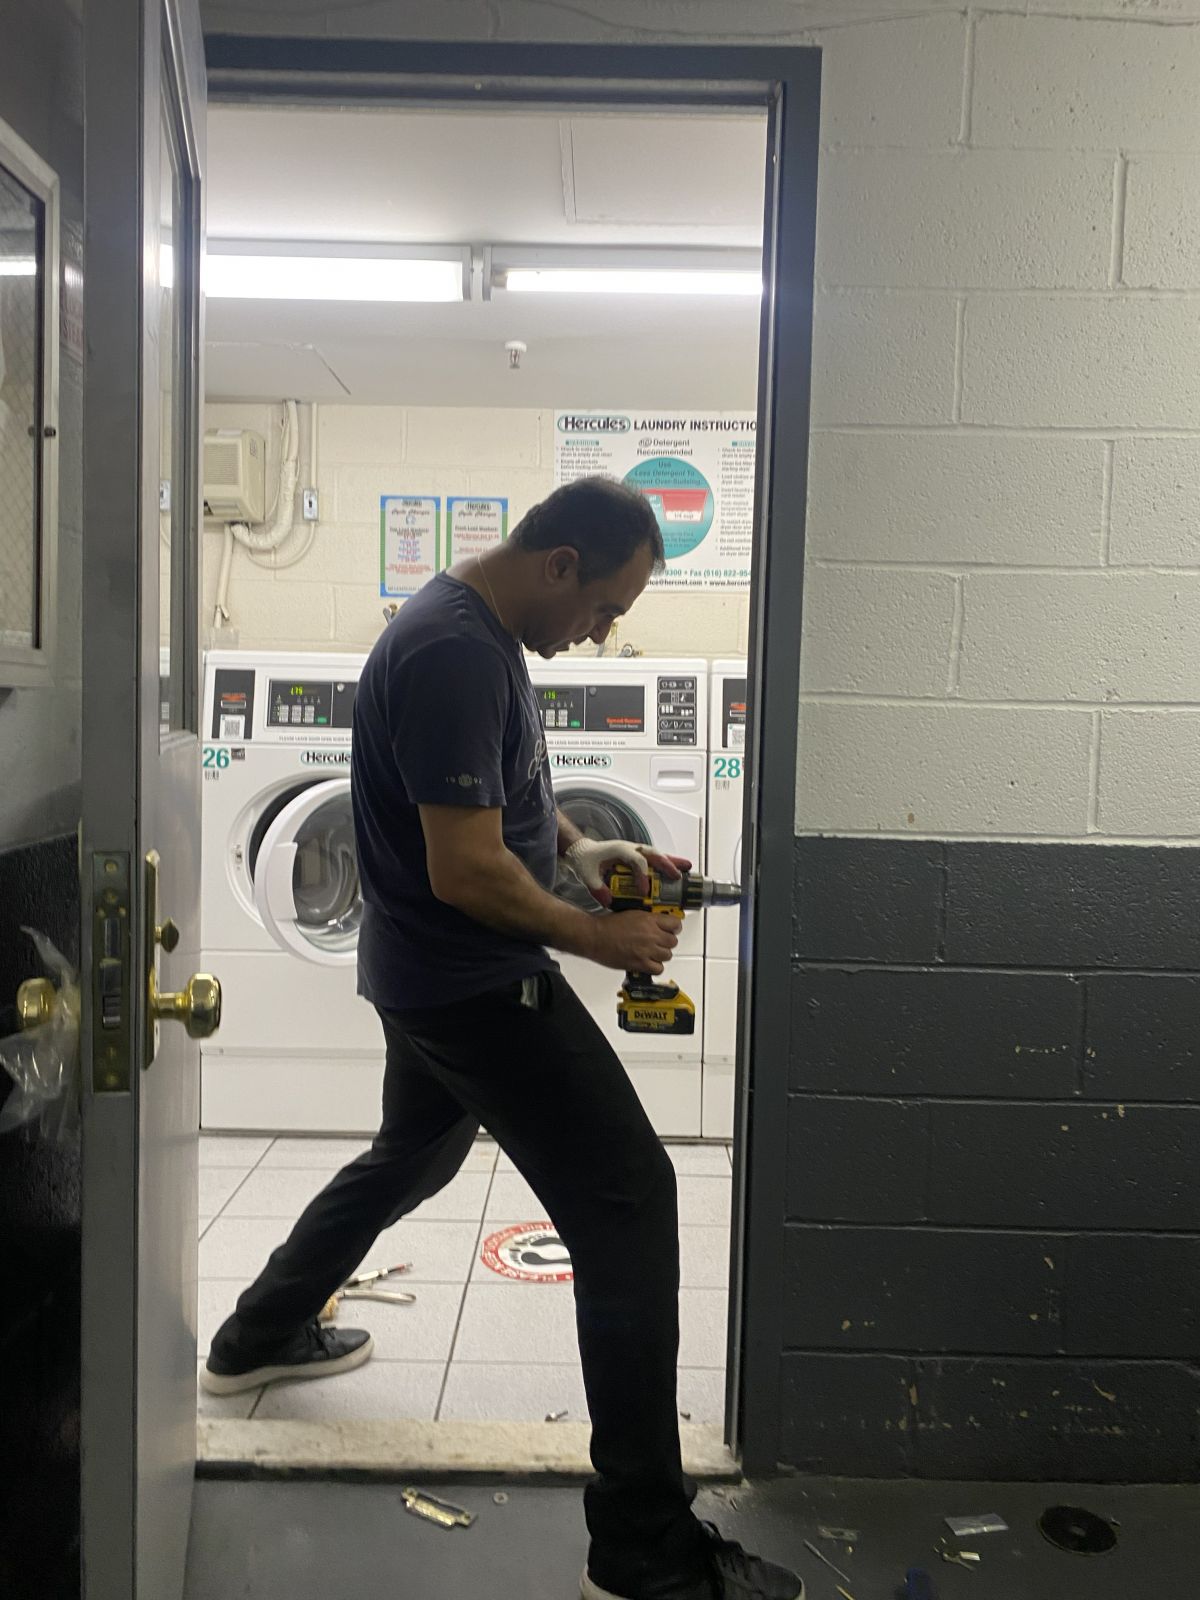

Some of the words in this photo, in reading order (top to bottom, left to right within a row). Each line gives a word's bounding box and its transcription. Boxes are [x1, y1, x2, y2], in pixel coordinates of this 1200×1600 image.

[563, 416, 627, 431] Hercules
[633, 420, 687, 431] LAUNDRY
[636, 448, 693, 456] Recommended
[203, 747, 229, 769] 26
[556, 754, 608, 766] Hercules
[714, 758, 741, 778] 28
